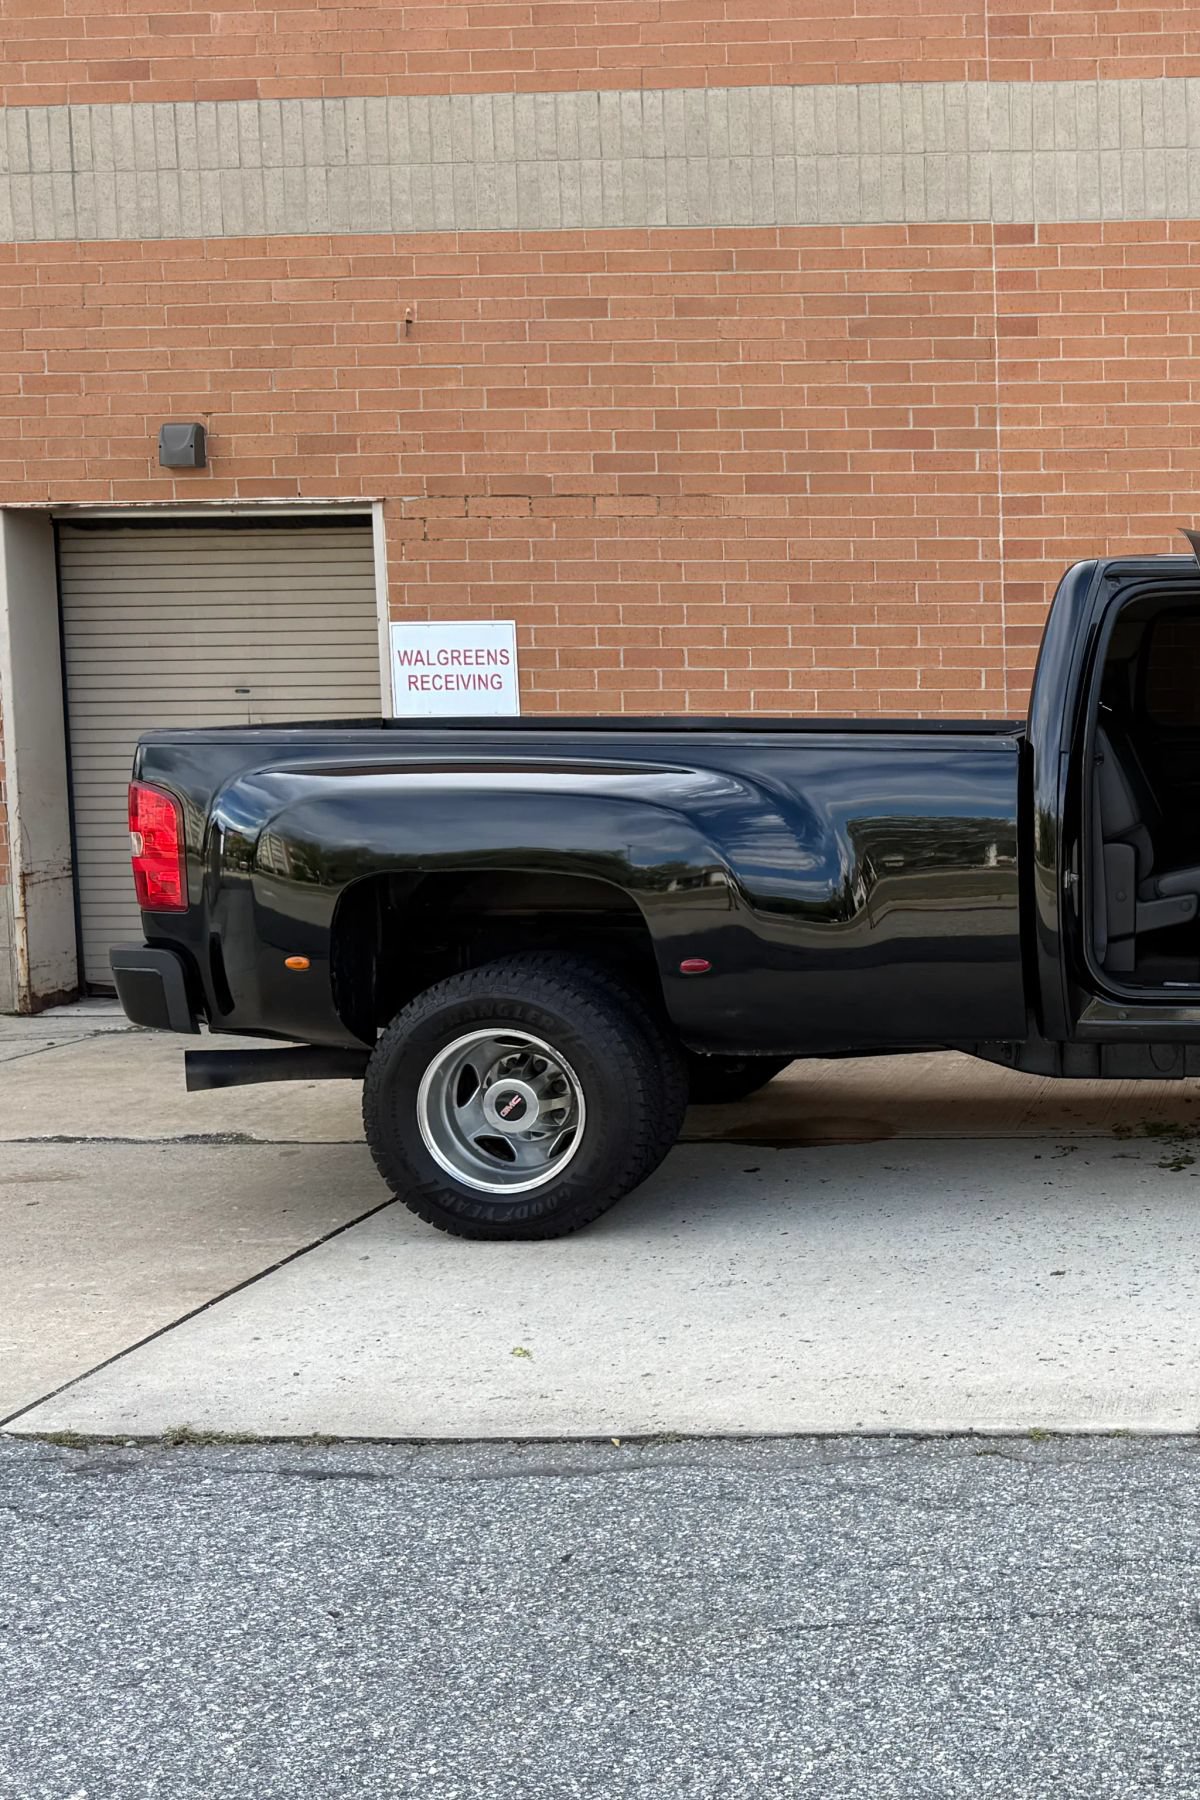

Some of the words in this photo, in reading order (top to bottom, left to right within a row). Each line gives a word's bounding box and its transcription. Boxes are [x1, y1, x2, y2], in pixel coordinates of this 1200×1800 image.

[398, 649, 510, 666] WALGREENS
[408, 674, 503, 691] RECEIVING
[500, 1095, 521, 1117] GMC
